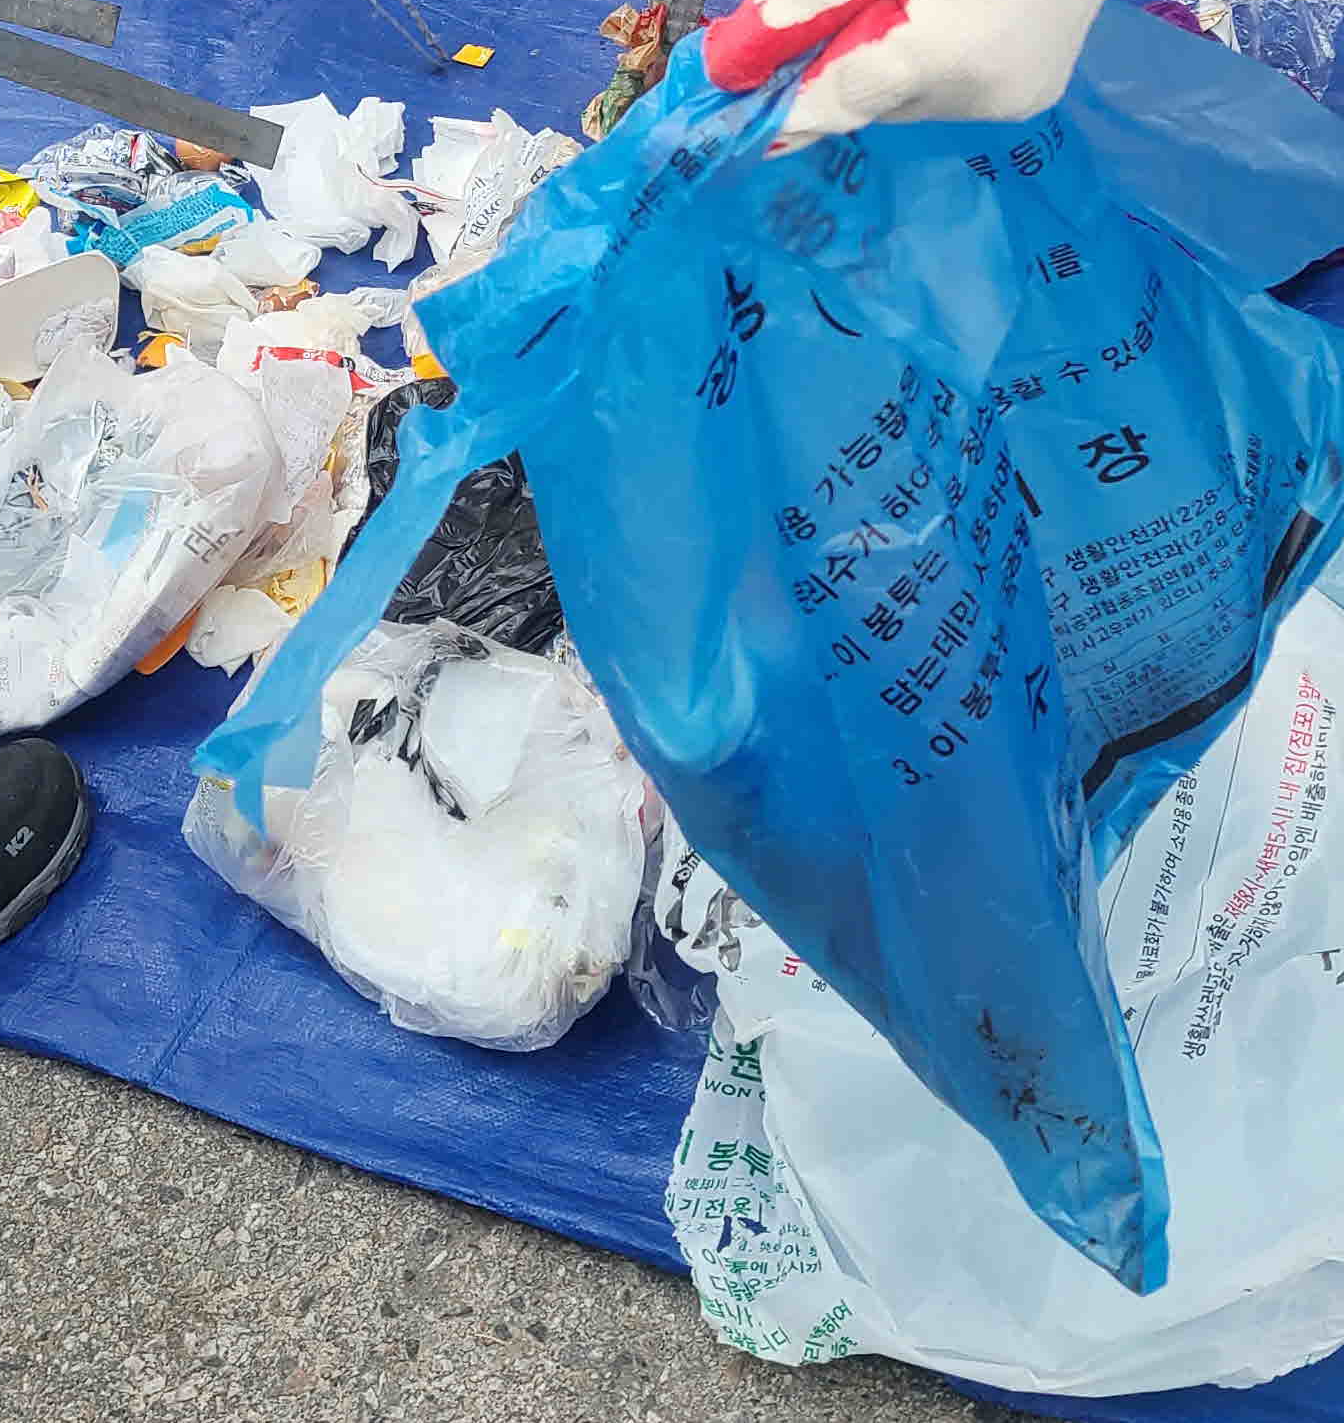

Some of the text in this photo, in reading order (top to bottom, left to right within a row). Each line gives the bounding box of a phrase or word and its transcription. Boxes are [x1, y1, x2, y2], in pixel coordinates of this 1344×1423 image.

[1059, 360, 1090, 384] 수
[1078, 425, 1151, 483] 장
[831, 632, 871, 667] 이
[861, 549, 950, 643] 봉투는
[879, 589, 981, 717] 담는데만
[928, 720, 970, 758] 이
[1282, 702, 1318, 776] 집(점포)
[1280, 780, 1301, 802] 내
[5, 826, 35, 857] K2
[1149, 849, 1184, 918] 불가하여
[707, 1138, 774, 1178] 봉투
